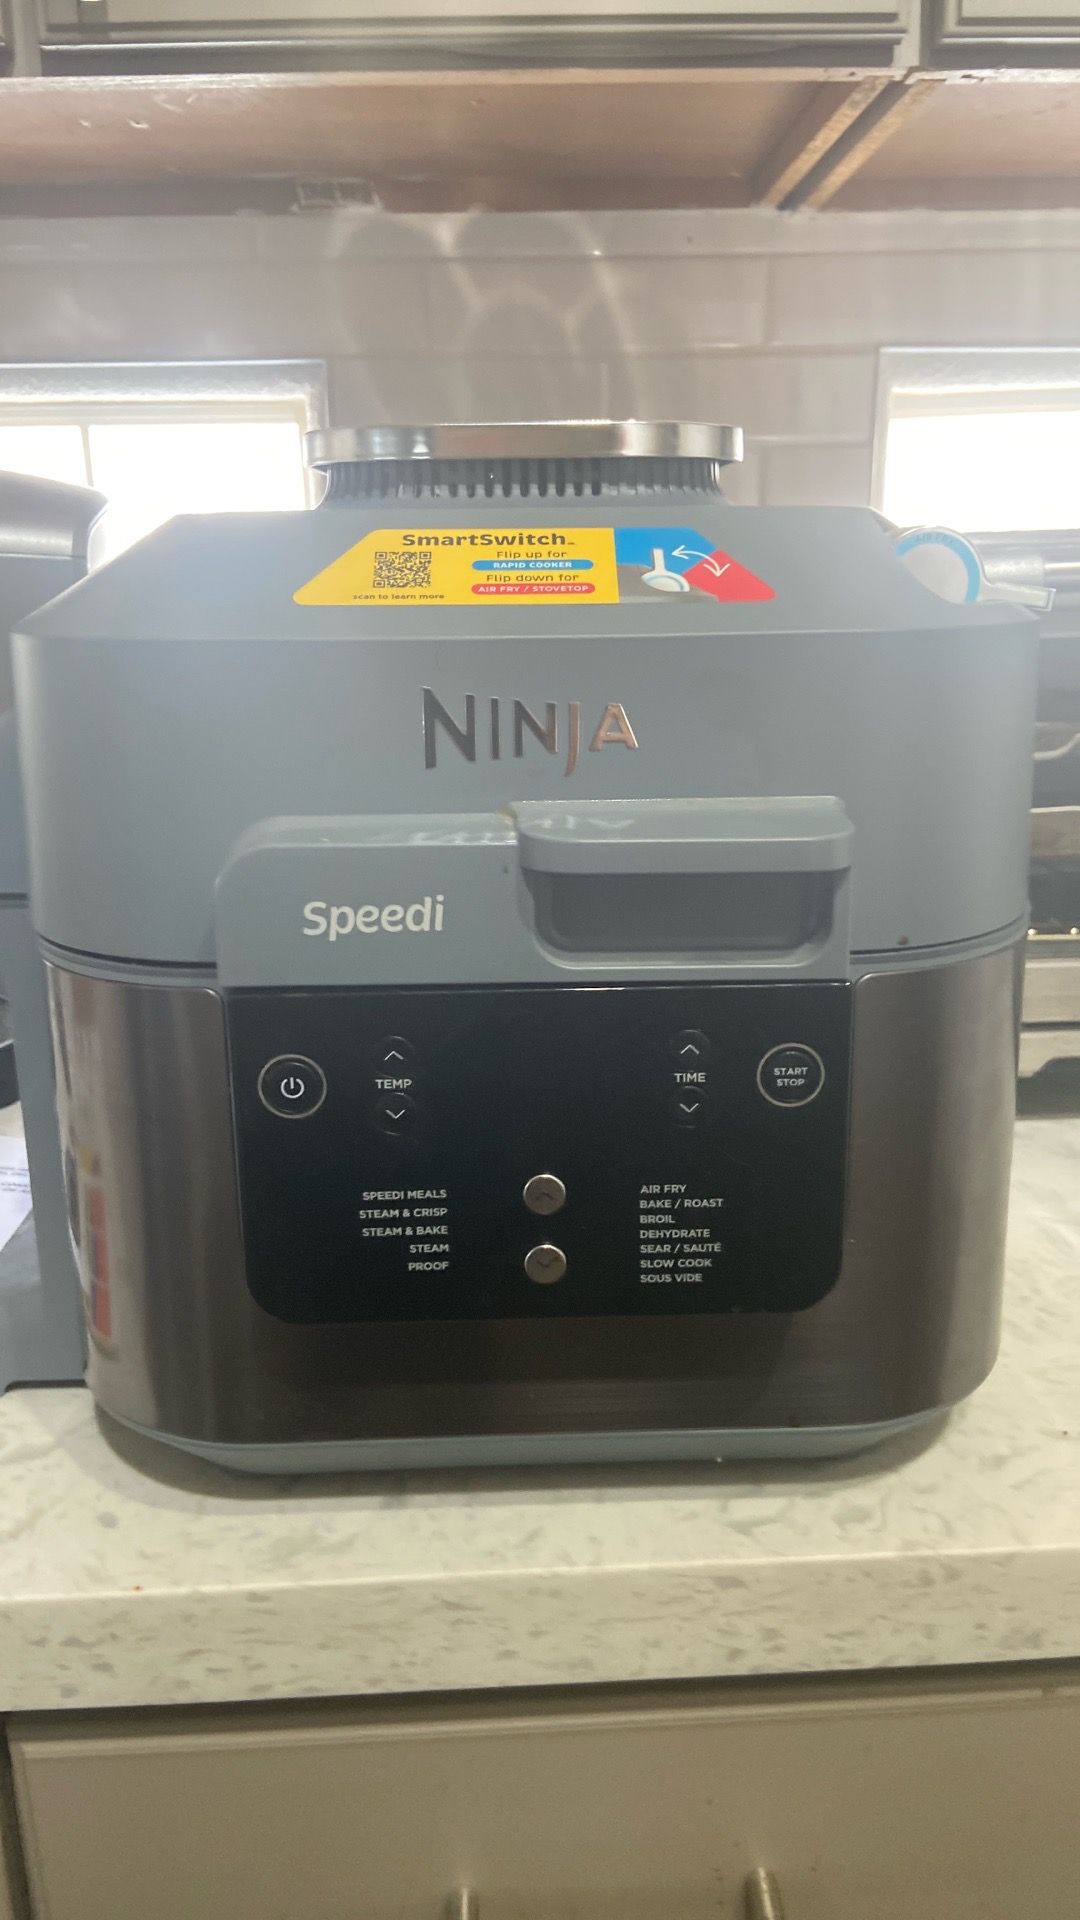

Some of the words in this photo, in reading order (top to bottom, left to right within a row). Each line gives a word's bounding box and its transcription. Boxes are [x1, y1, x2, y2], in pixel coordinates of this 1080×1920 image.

[402, 533, 567, 547] SmartSwitch
[496, 550, 521, 560] Flip
[525, 552, 543, 560] up
[547, 550, 567, 559] for
[492, 561, 525, 569] RAPID
[528, 560, 573, 569] COOKER
[486, 573, 513, 583] Flip
[515, 573, 555, 582] down
[559, 573, 579, 582] for
[477, 585, 498, 593] AIR
[499, 585, 521, 593] FRY
[523, 585, 530, 593] /
[532, 584, 589, 593] STOVETOP
[303, 894, 444, 941] Speedi
[773, 1067, 808, 1076] START
[674, 1072, 707, 1083] TIME
[776, 1078, 805, 1087] STOP
[374, 1078, 413, 1089] TEMP
[640, 1184, 661, 1194] AIR
[664, 1184, 687, 1193] FRY
[362, 1191, 405, 1201] SPEEDI
[407, 1189, 448, 1199] MEALS
[639, 1199, 672, 1209] BAKE
[674, 1198, 681, 1209] /
[684, 1198, 724, 1208] ROAST
[359, 1209, 400, 1219] STEAM
[402, 1208, 411, 1218] &
[413, 1207, 448, 1217] CRISP
[639, 1214, 676, 1224] BROIL
[362, 1226, 403, 1237] STEAM
[405, 1226, 413, 1236] &
[416, 1225, 449, 1235] BAKE
[639, 1228, 711, 1239] DEHYDRATE
[409, 1243, 450, 1253] STEAM
[640, 1244, 672, 1253] SEAR
[674, 1243, 680, 1254] /
[683, 1241, 722, 1253] SAUTÉ
[408, 1261, 449, 1271] PROOF
[640, 1259, 675, 1268] SLOW
[677, 1258, 712, 1268] COOK
[640, 1274, 672, 1283] SOUS
[674, 1273, 703, 1282] VIDE
